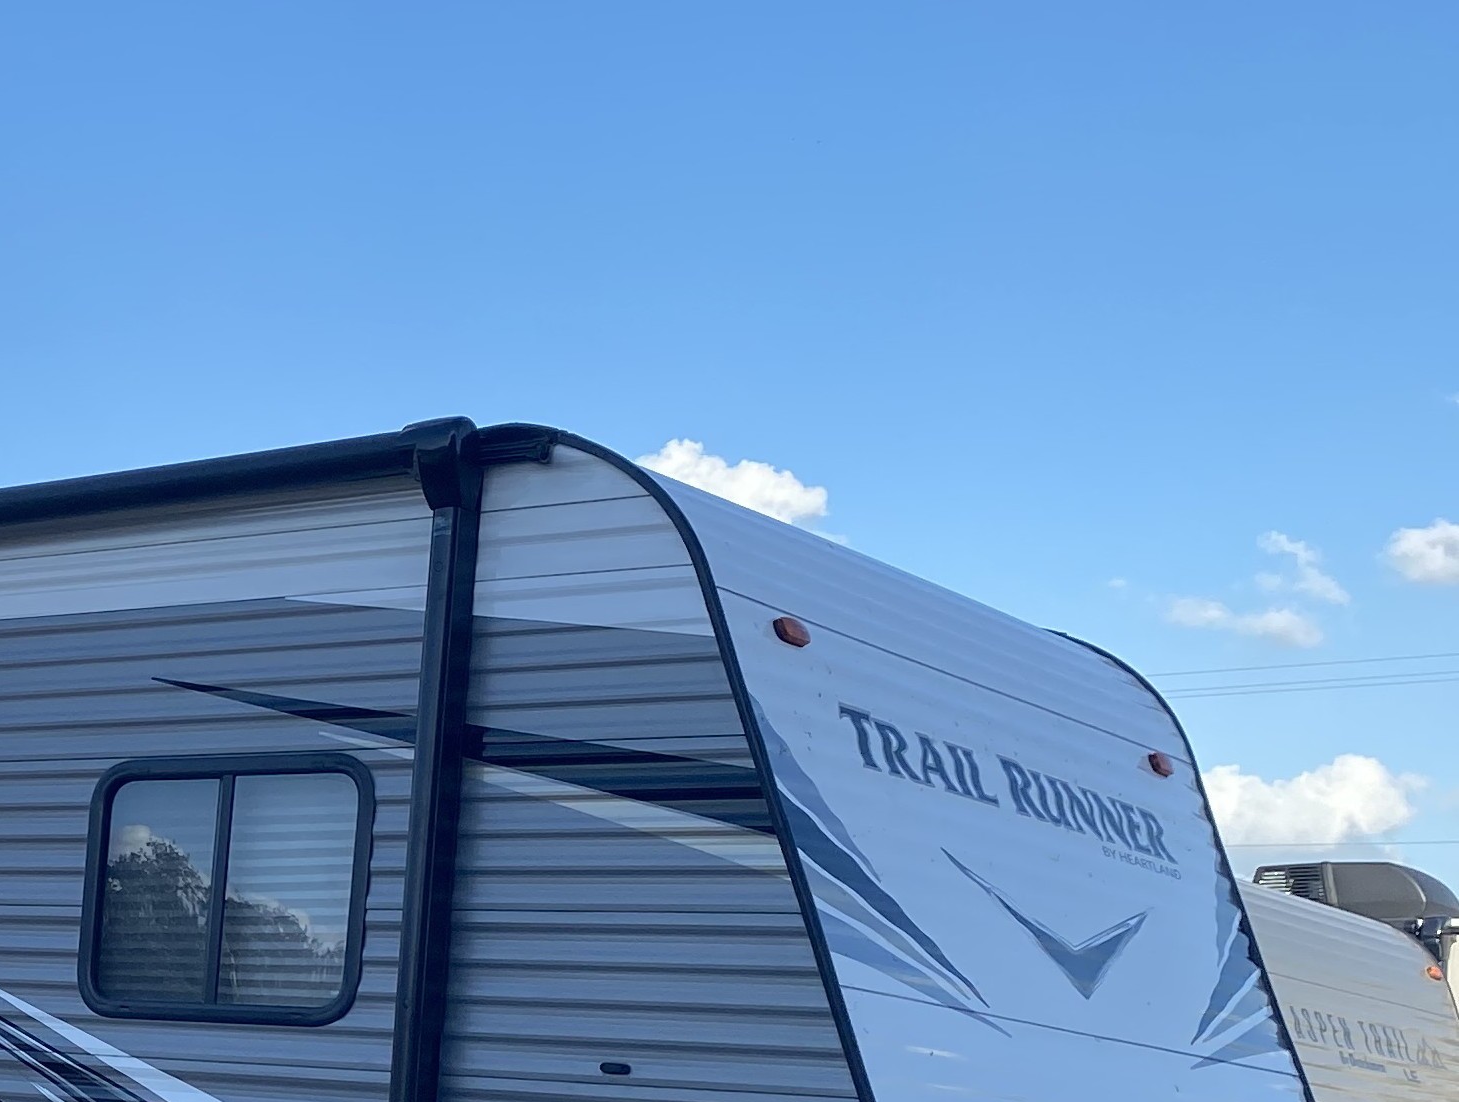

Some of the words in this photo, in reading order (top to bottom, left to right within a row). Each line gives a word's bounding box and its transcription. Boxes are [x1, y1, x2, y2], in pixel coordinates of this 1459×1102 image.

[838, 702, 1000, 808] TRAIL
[996, 754, 1179, 865] RUNNER
[1102, 846, 1116, 859] BY
[1119, 851, 1182, 881] HEARTLAND
[1290, 1005, 1355, 1050] ASPEN
[1357, 1020, 1415, 1063] TRAIL
